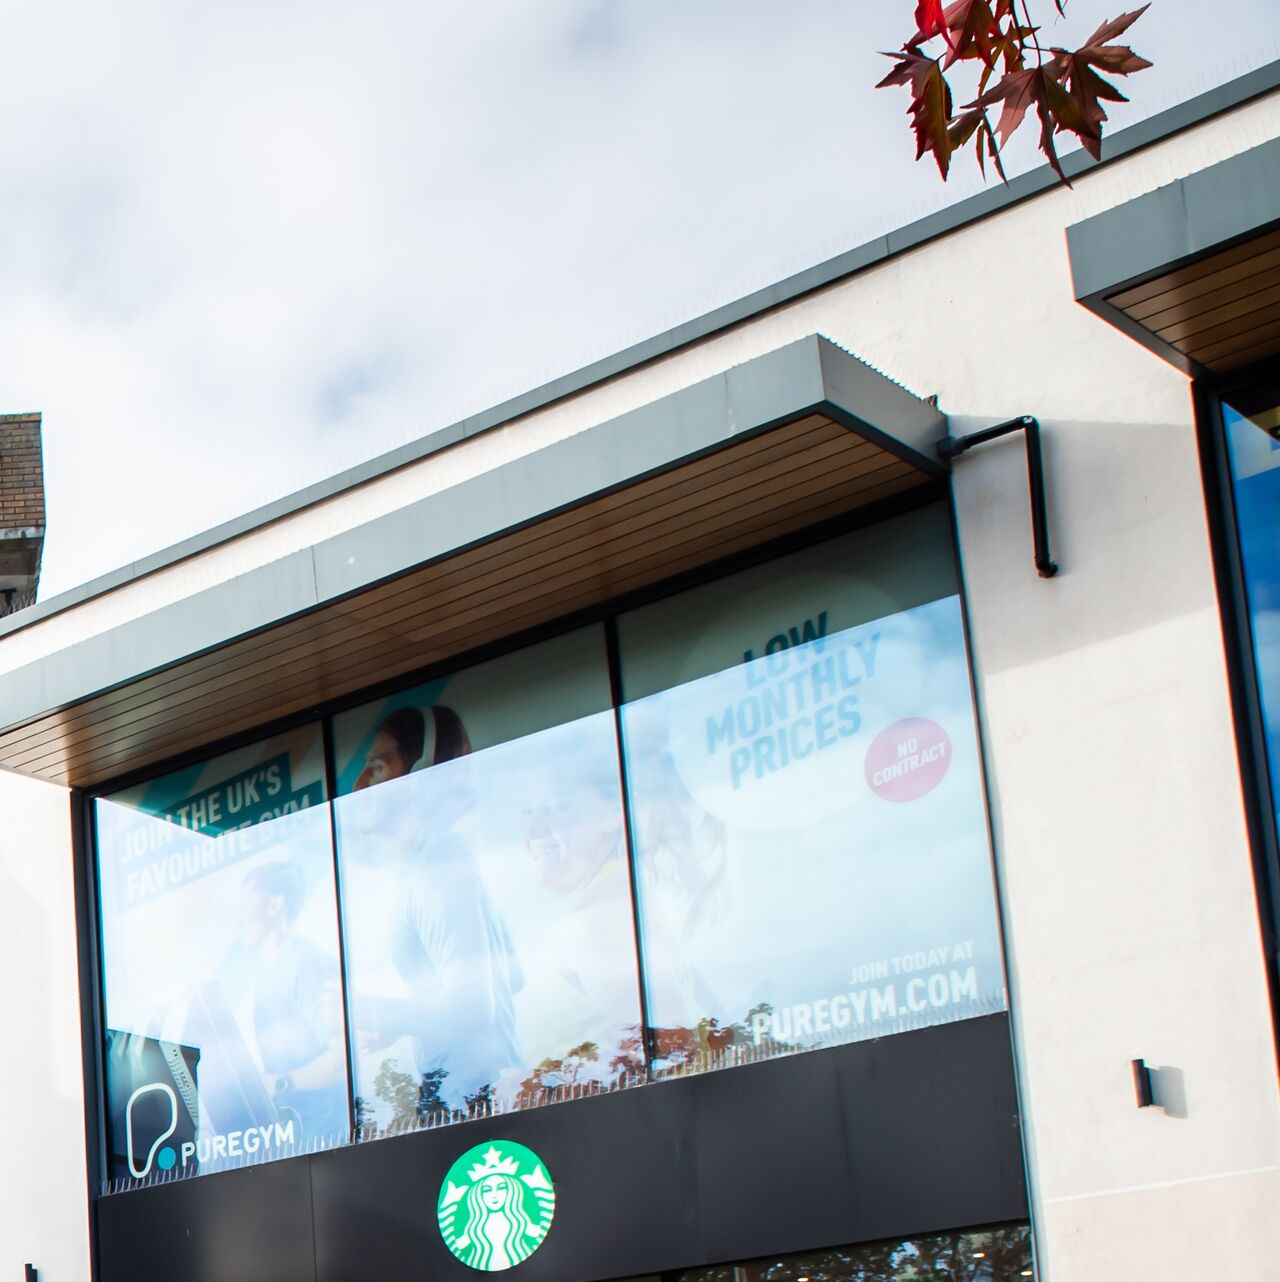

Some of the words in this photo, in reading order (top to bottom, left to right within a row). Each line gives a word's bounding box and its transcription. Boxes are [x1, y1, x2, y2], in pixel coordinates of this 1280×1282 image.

[743, 610, 828, 690] LOW
[704, 632, 881, 755] MONTHLY
[729, 694, 862, 791] PRICES
[872, 742, 946, 787] CONTRACT
[897, 737, 918, 758] NO
[123, 814, 172, 863] JOIN
[176, 792, 222, 831] THE
[226, 764, 283, 814] UK'S
[127, 821, 253, 903] FAVOURITE
[259, 794, 310, 848] GYM
[849, 960, 889, 985] JOIN
[893, 945, 949, 975] TODAY
[951, 940, 975, 962] AT
[753, 966, 978, 1045] PUREGYM.COM
[181, 1119, 294, 1167] PUREGYM
